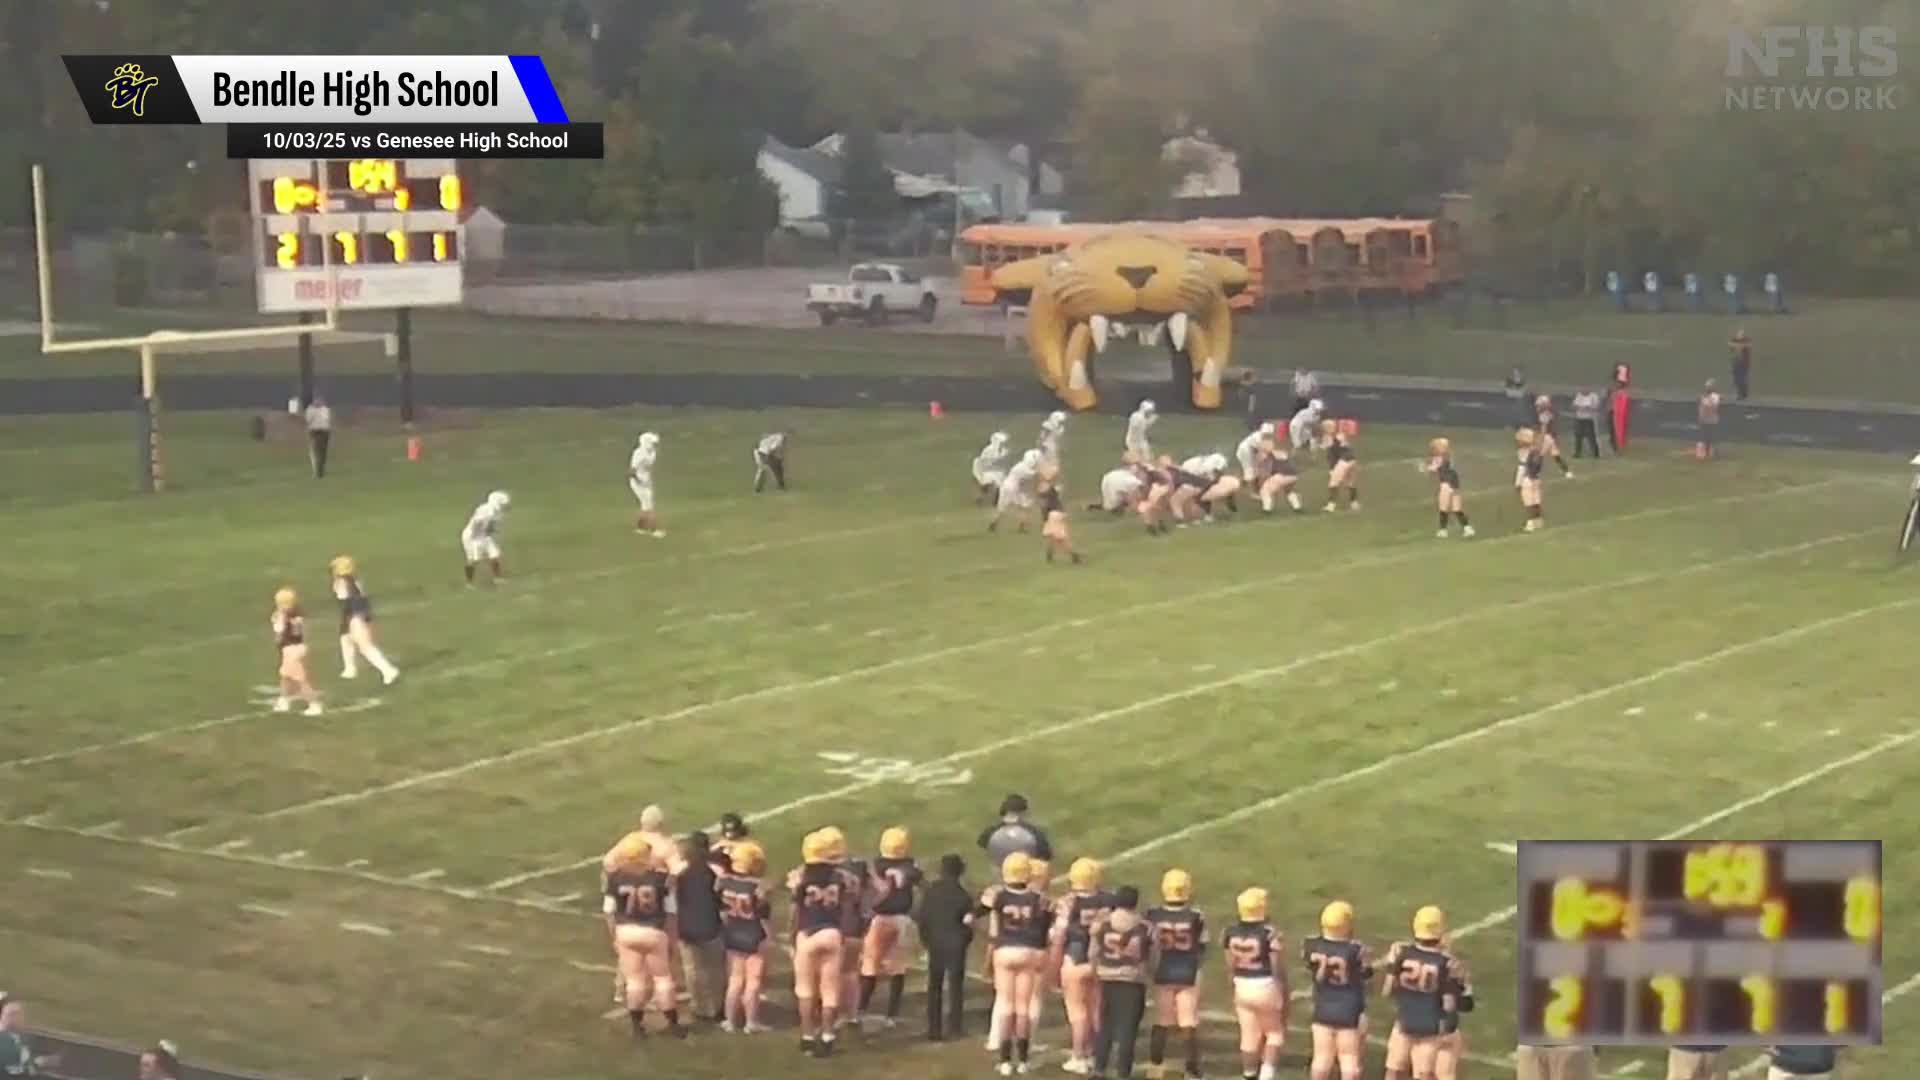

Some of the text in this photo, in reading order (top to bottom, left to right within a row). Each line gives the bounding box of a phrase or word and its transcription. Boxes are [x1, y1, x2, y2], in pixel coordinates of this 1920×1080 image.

[276, 231, 298, 270] 2
[1103, 934, 1142, 960] 54
[1311, 952, 1349, 985] 73
[1399, 959, 1439, 994] 20
